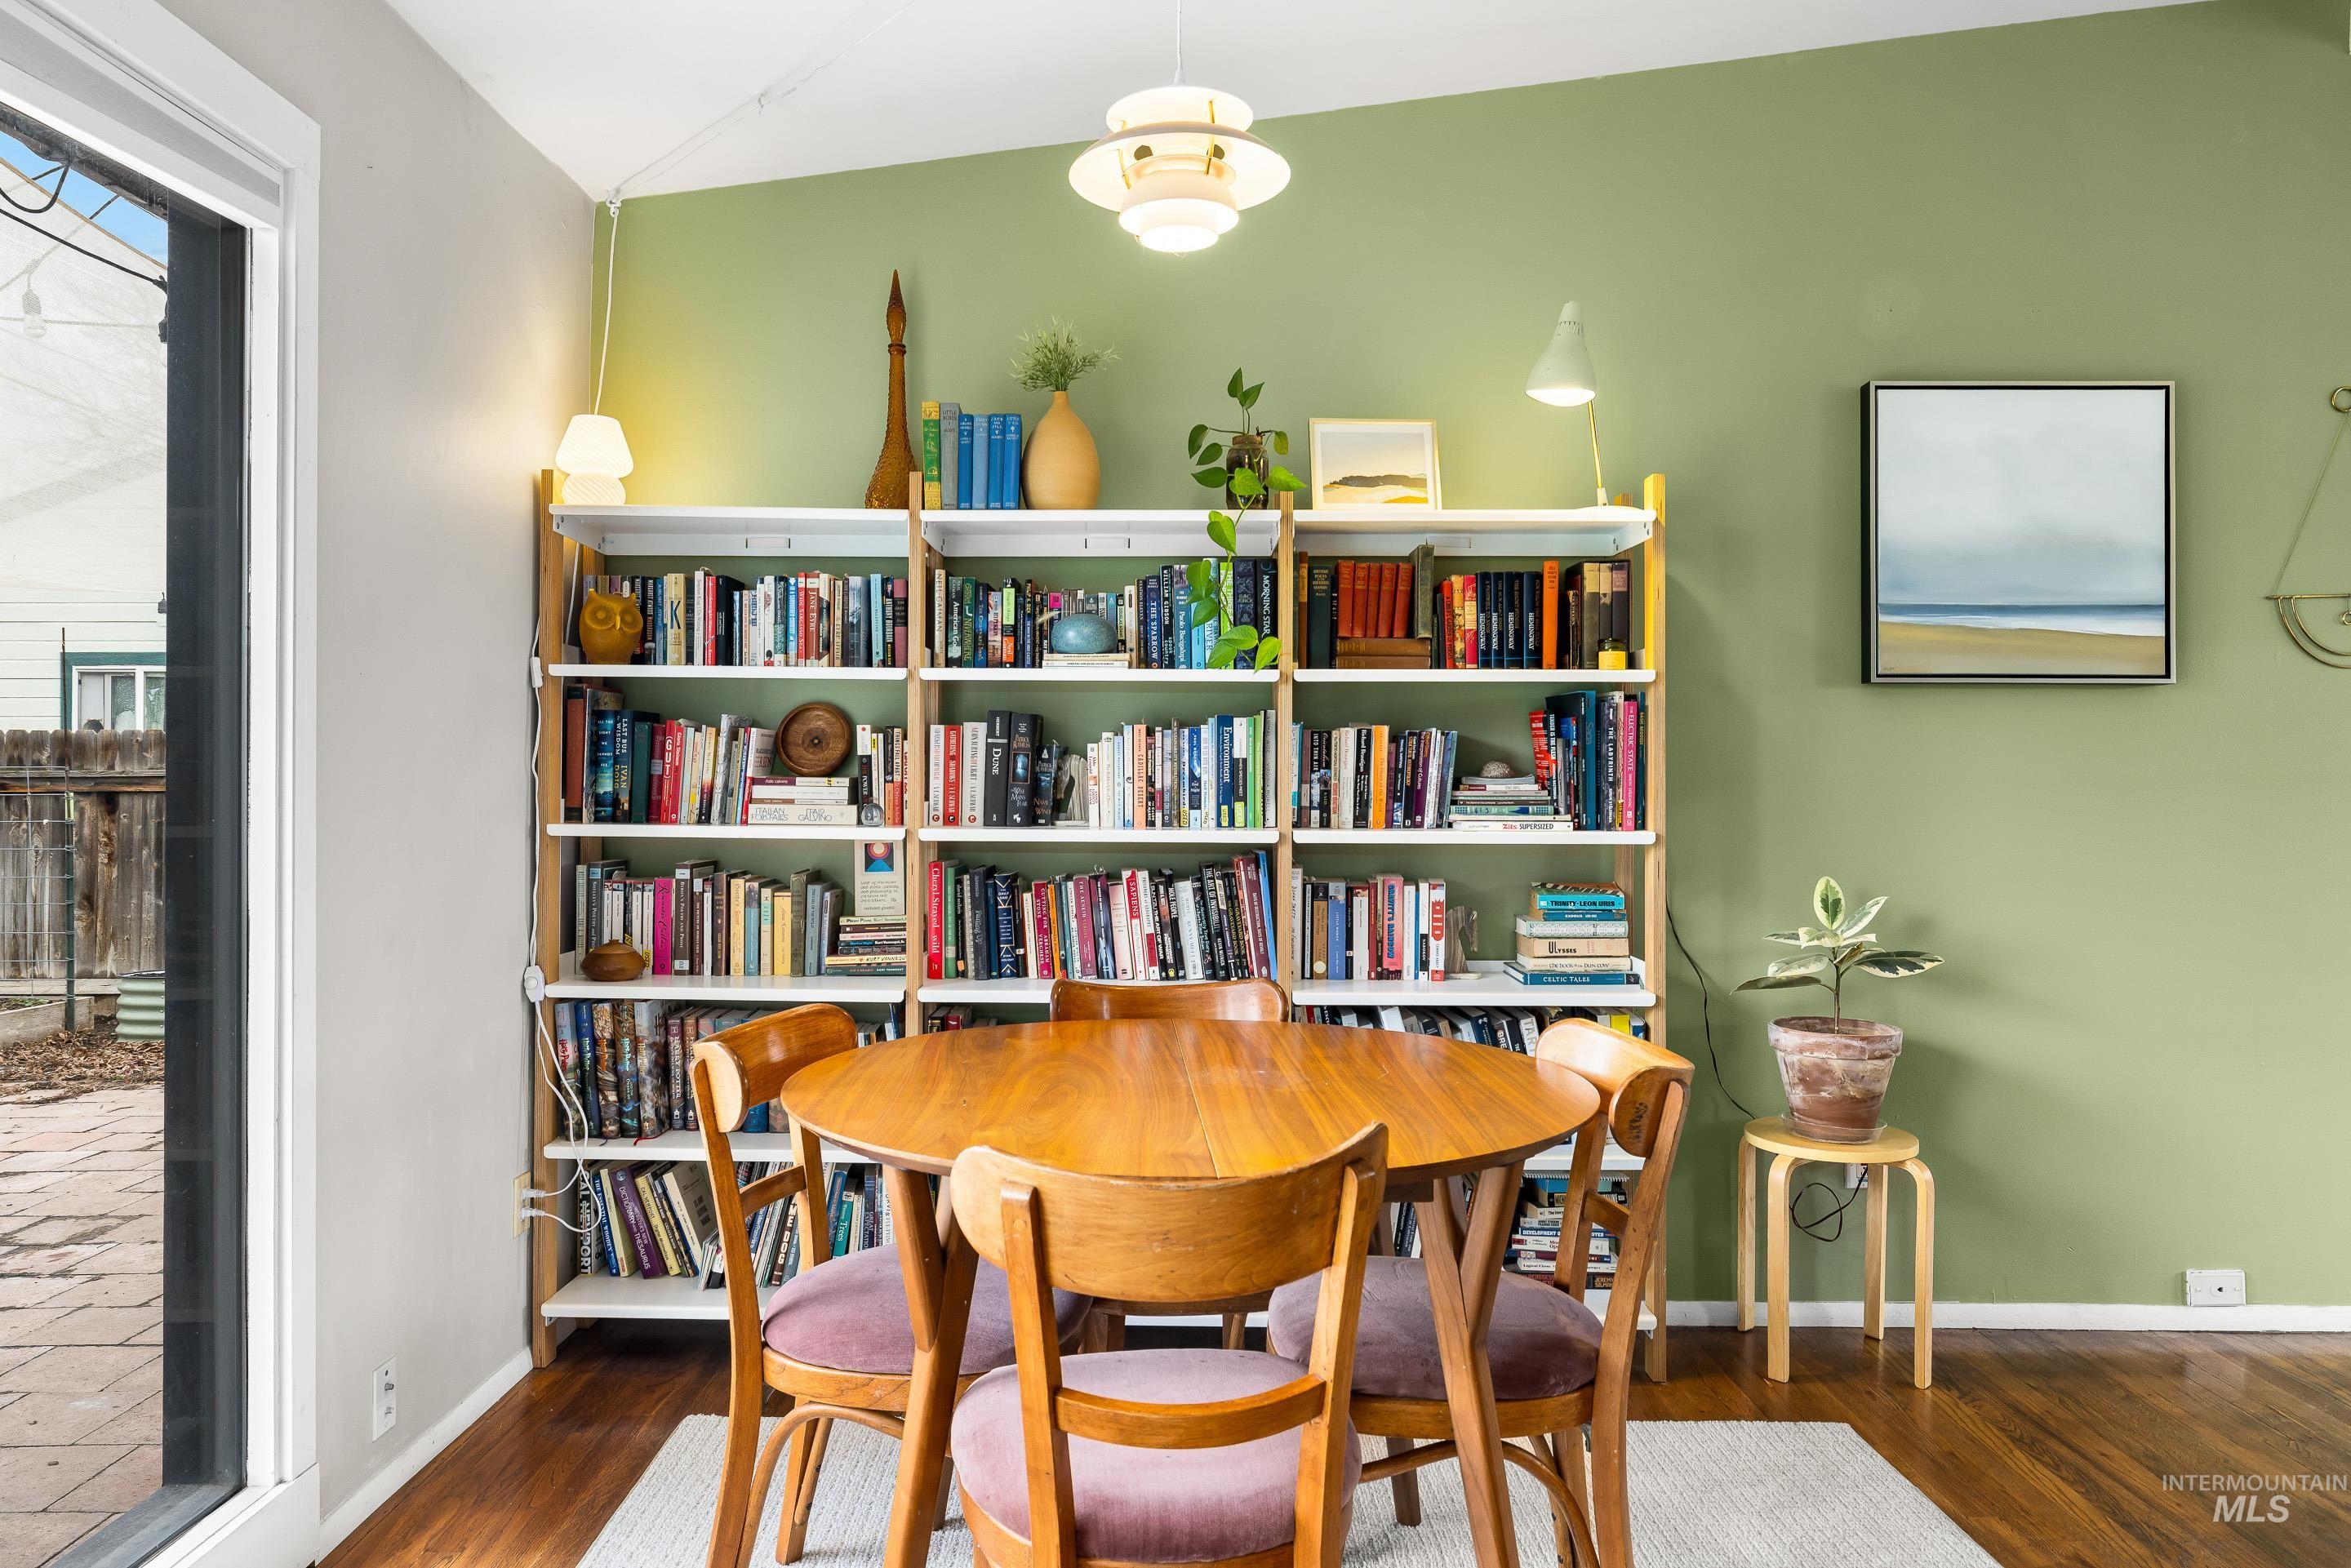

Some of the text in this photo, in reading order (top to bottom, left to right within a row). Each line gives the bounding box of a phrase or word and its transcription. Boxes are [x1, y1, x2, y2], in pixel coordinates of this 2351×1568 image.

[1261, 575, 1270, 637] MORNING STAR
[992, 748, 1002, 775] DUNE
[1223, 726, 1232, 783] Environment
[798, 814, 832, 822] CALVINO
[657, 883, 670, 921] Romantic
[931, 868, 940, 953] Cheryl Strayed wild
[1129, 882, 1139, 916] SAPIENS
[1168, 887, 1178, 918] MOLE PEOPLE
[1209, 899, 1220, 933] INVISIBILITY
[1228, 908, 1236, 936] GRAVEYARD
[1234, 908, 1242, 936] GRAVEYARD
[1156, 935, 1161, 944] OF
[1549, 941, 1577, 954] ULYSSES
[580, 1170, 589, 1196] CAL
[602, 1225, 612, 1252] WOODEN
[619, 1186, 651, 1269] DICTIONARY THESAURUS
[837, 1221, 847, 1242] Trees
